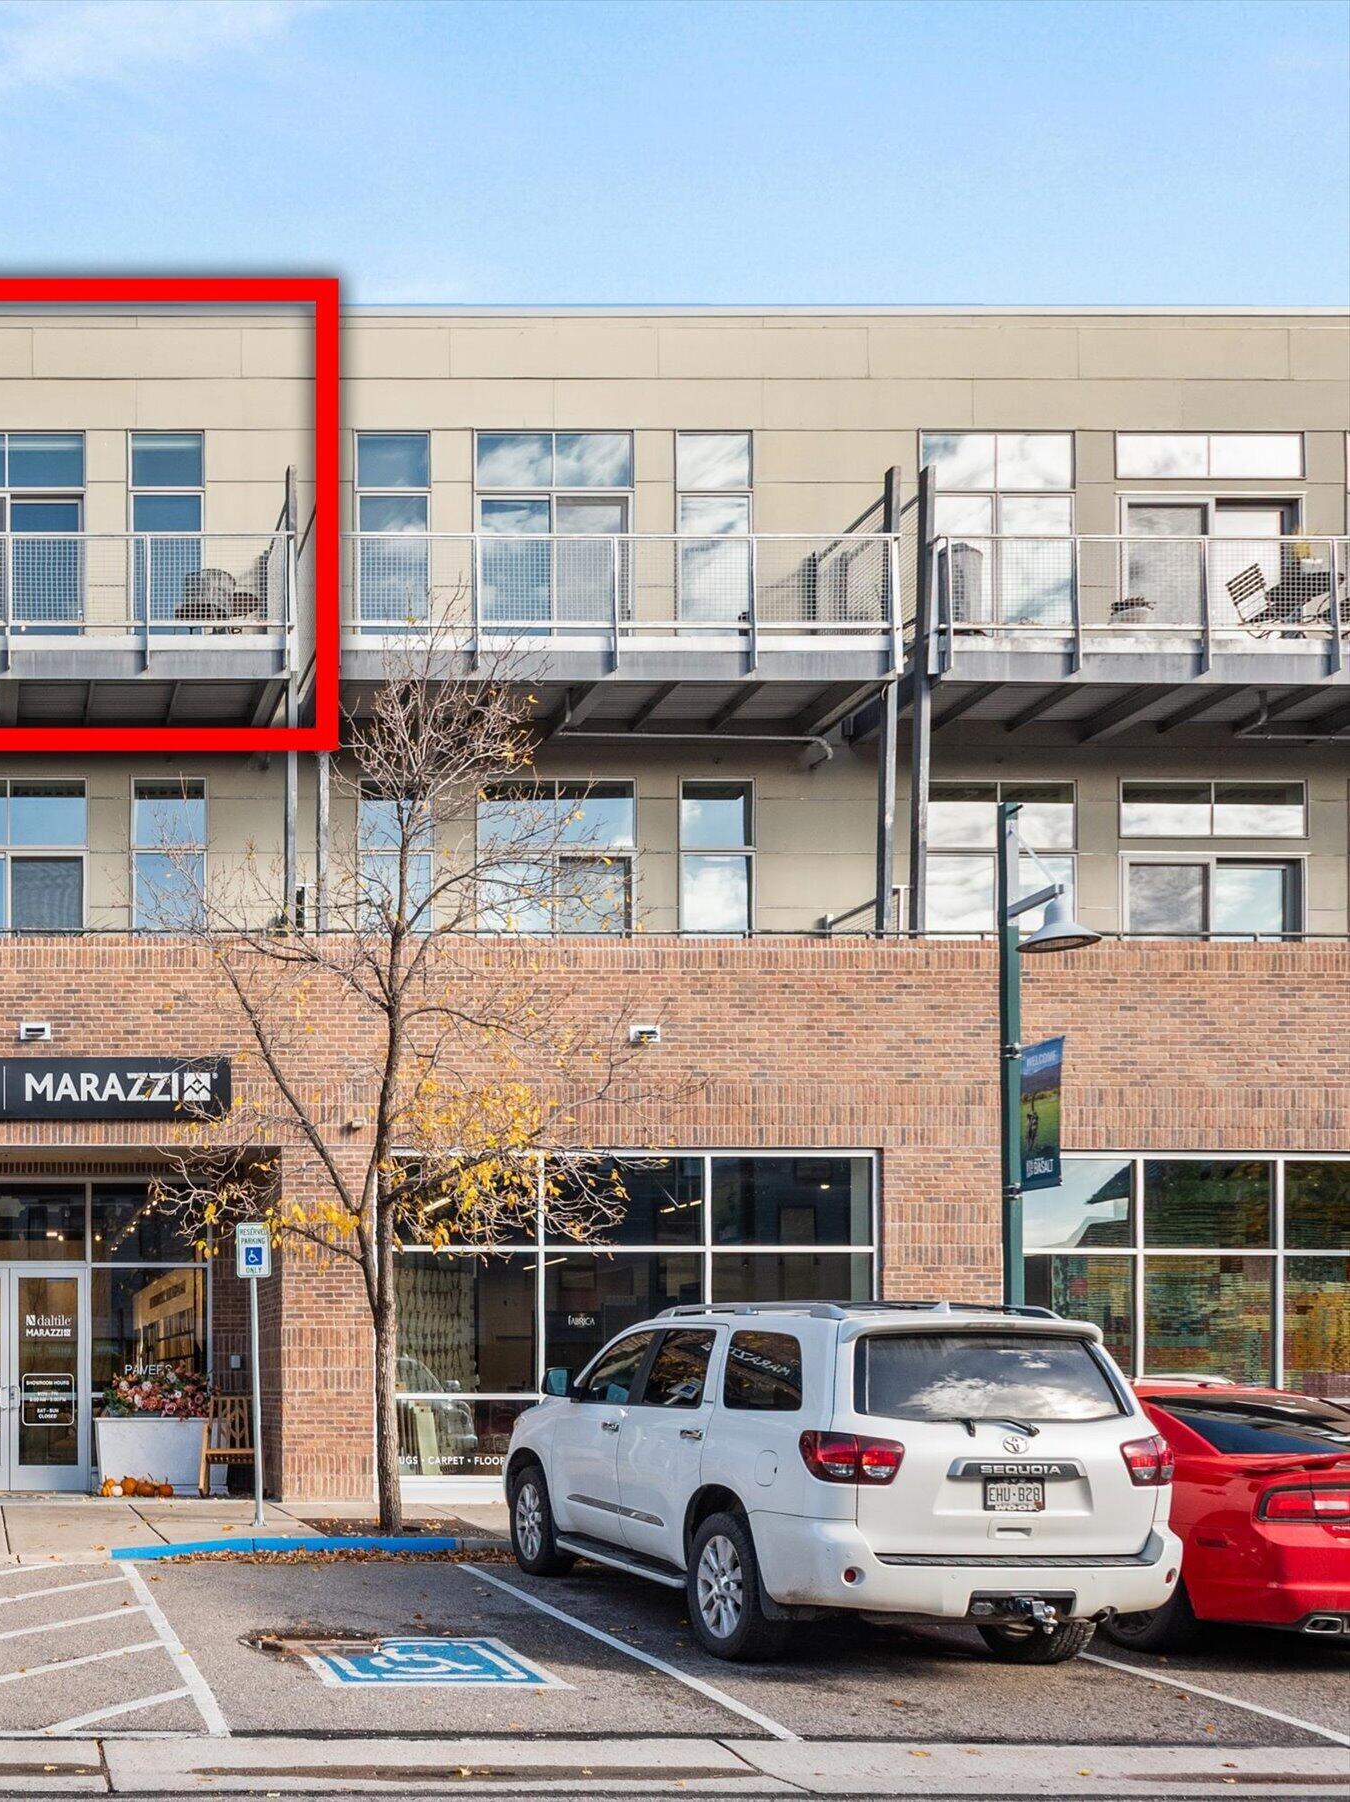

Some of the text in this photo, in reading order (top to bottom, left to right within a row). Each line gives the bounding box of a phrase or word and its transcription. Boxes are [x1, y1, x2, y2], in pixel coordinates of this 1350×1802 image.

[1026, 1050, 1057, 1067] WELCOME
[25, 1073, 179, 1101] MARAZZI
[240, 1237, 266, 1245] PARKING
[245, 1266, 263, 1274] ONLY
[36, 1314, 71, 1327] daltile
[26, 1328, 63, 1337] MARAZZI
[399, 1457, 418, 1465] UGS
[428, 1456, 464, 1465] CARPET
[980, 1465, 1062, 1475] SEQUOIA
